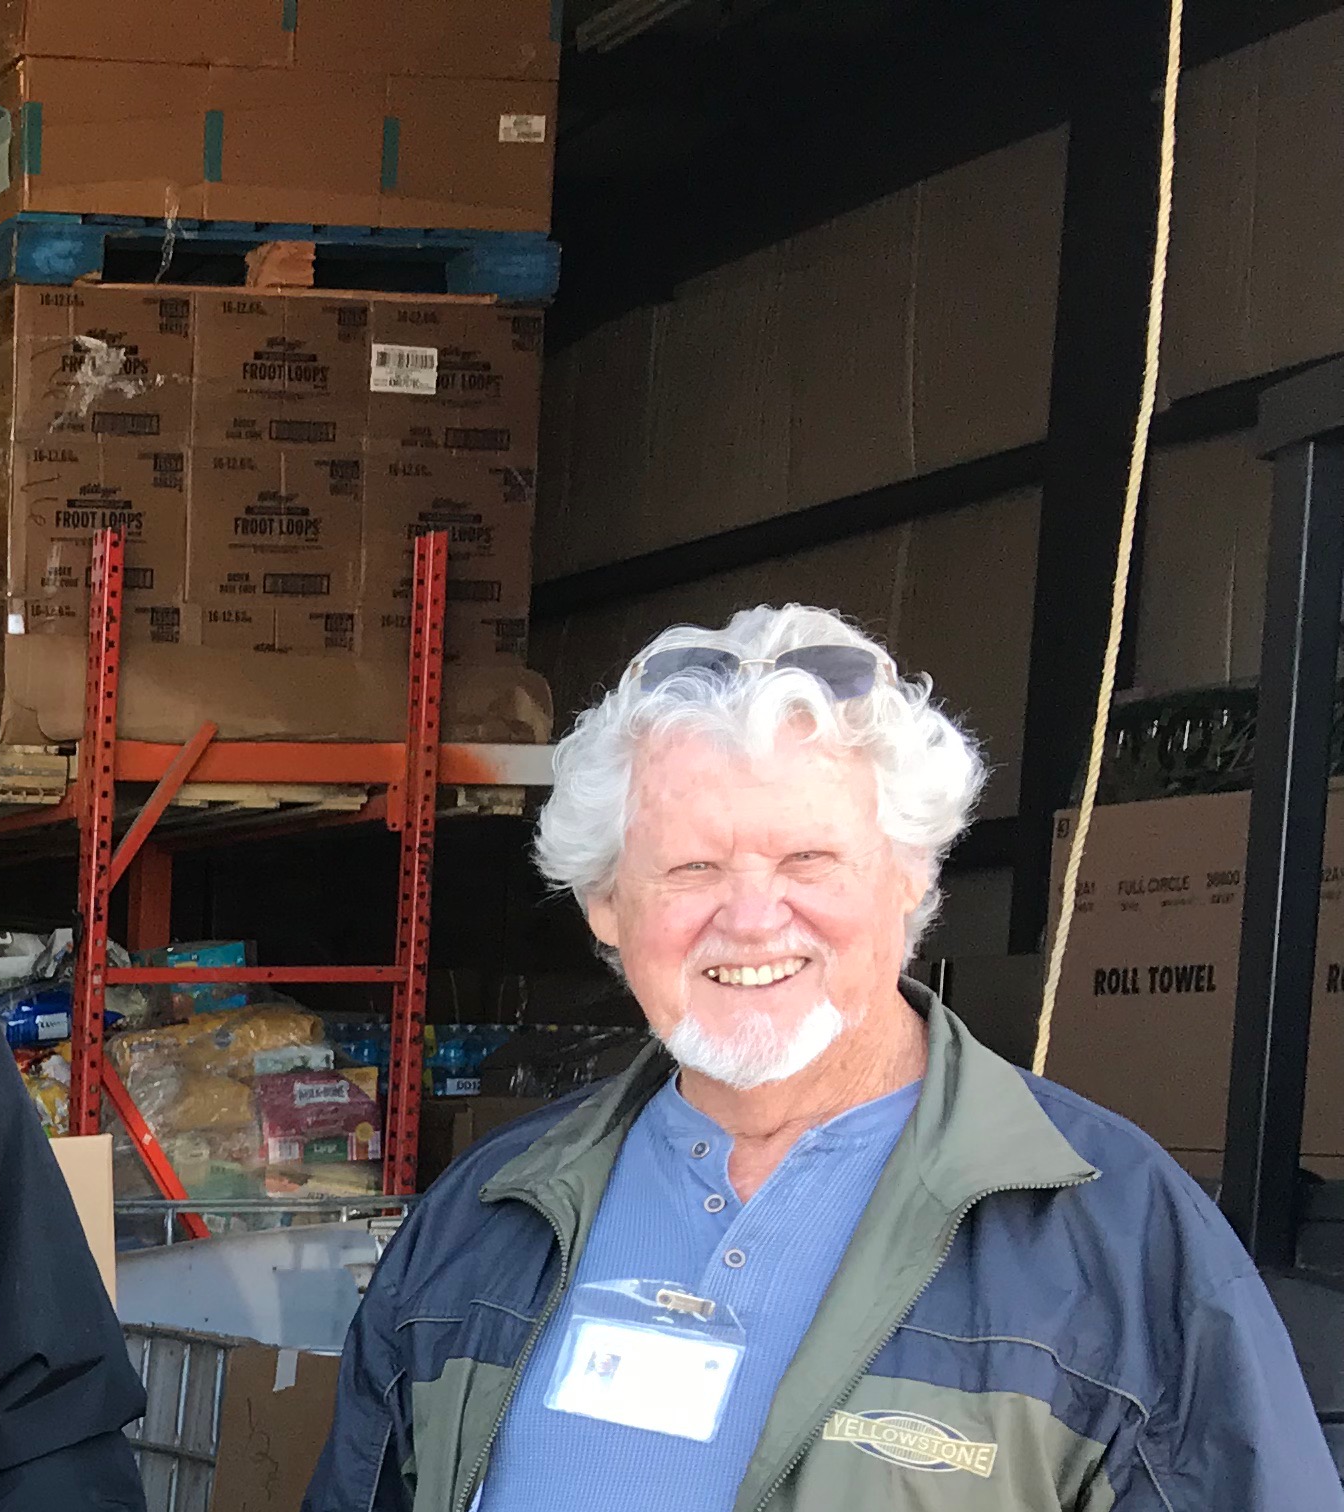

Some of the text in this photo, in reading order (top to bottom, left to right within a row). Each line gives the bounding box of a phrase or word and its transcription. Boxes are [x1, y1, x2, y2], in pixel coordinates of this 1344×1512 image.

[55, 511, 143, 529] FROOT LOOPS
[234, 517, 321, 536] FROOT LOOPS
[1094, 964, 1217, 996] ROLL TOWEL
[833, 1414, 991, 1470] YELLOWSTONE
